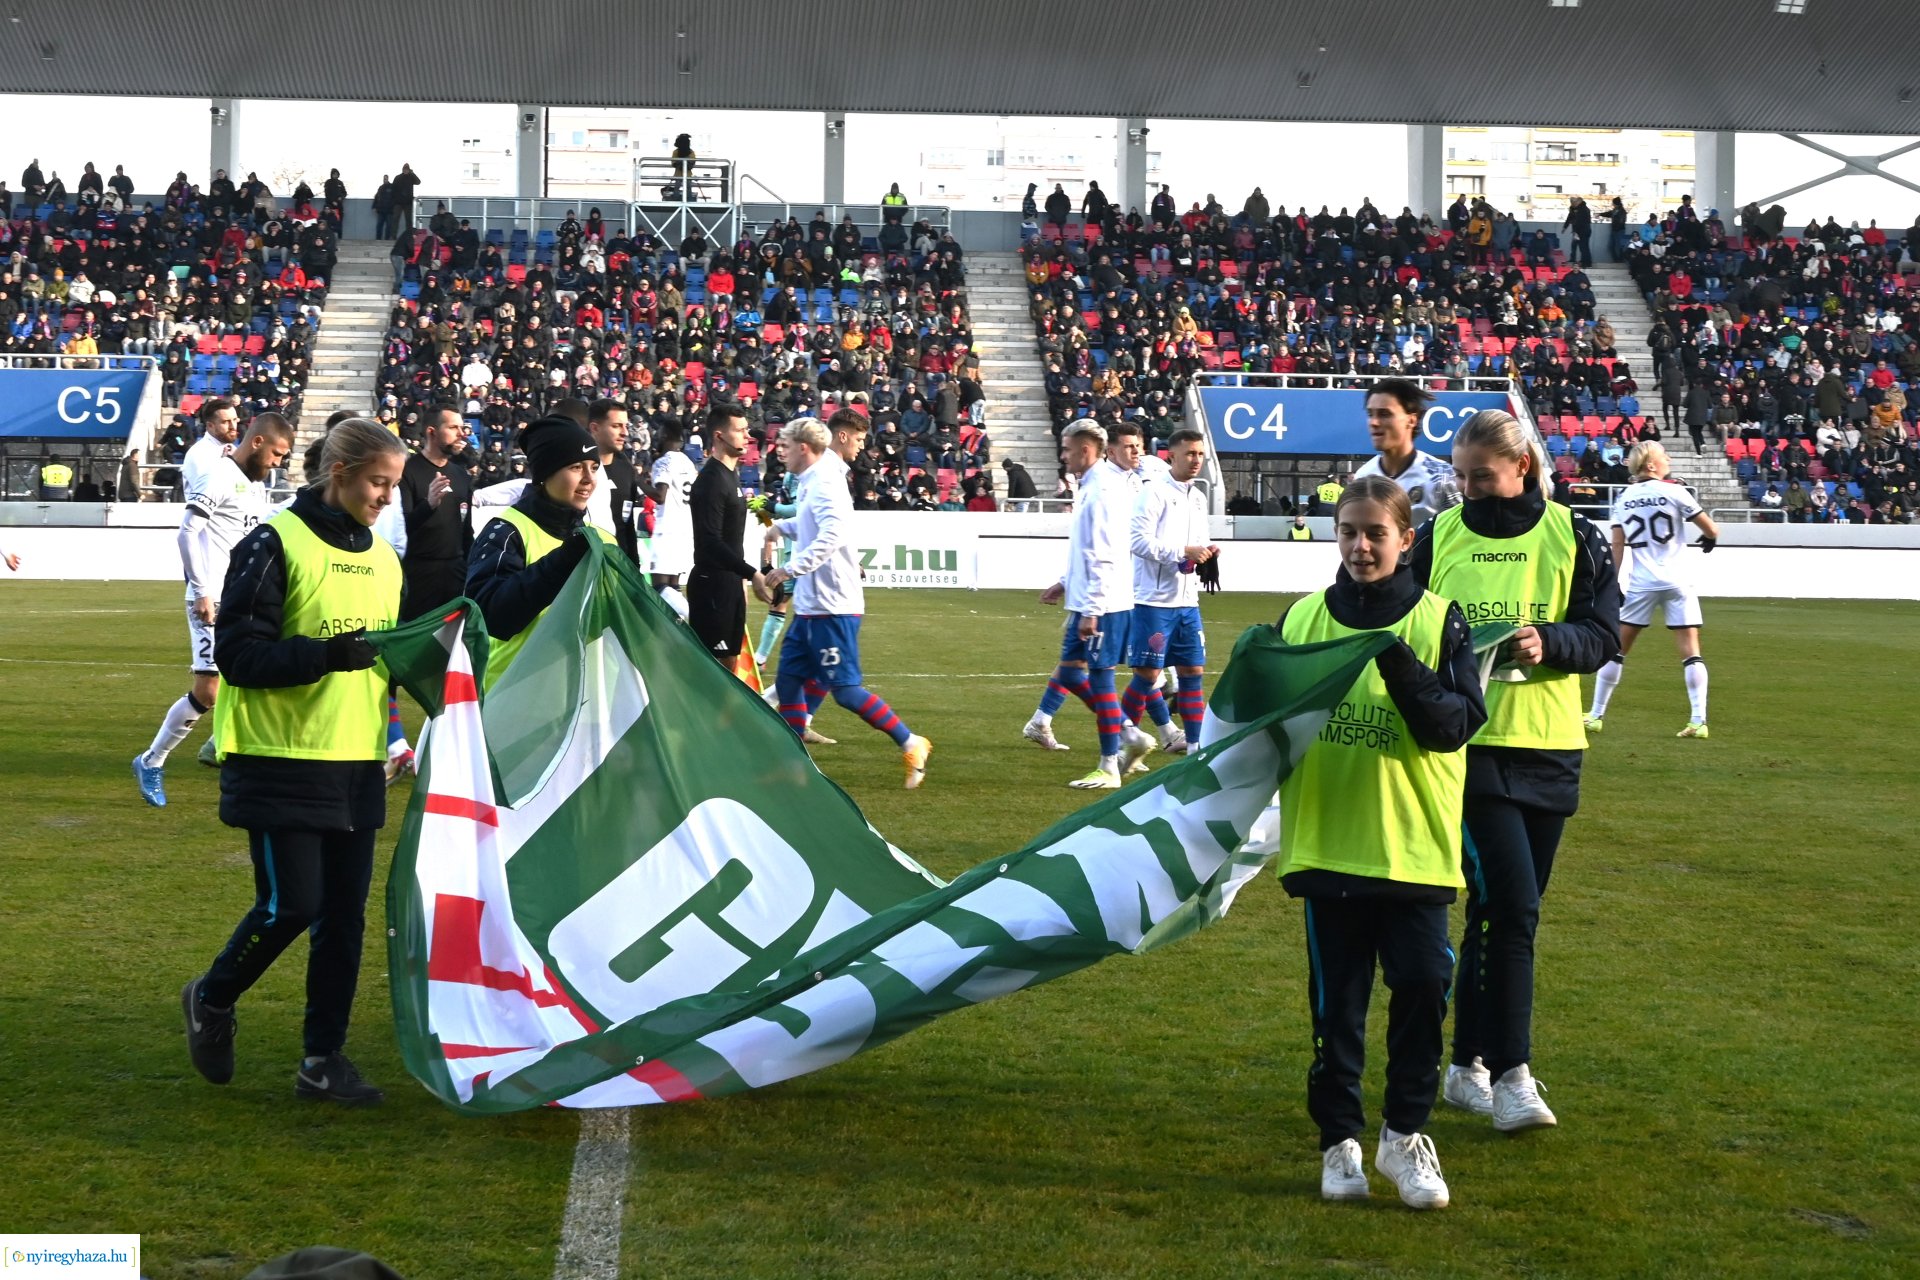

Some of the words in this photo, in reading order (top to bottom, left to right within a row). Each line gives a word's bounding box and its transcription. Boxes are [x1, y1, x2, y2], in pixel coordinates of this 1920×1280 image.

[57, 386, 121, 424] C5
[1223, 402, 1288, 440] C4
[1422, 406, 1478, 443] C
[1624, 497, 1667, 510] SOISALO
[1623, 510, 1675, 549] 20
[331, 563, 375, 576] macron
[857, 544, 958, 572] z.hu
[1471, 552, 1527, 563] macron
[318, 617, 391, 637] ABSOLUT
[820, 647, 841, 667] 23
[1330, 702, 1396, 731] OLUTE
[1319, 723, 1400, 755] MSPORT
